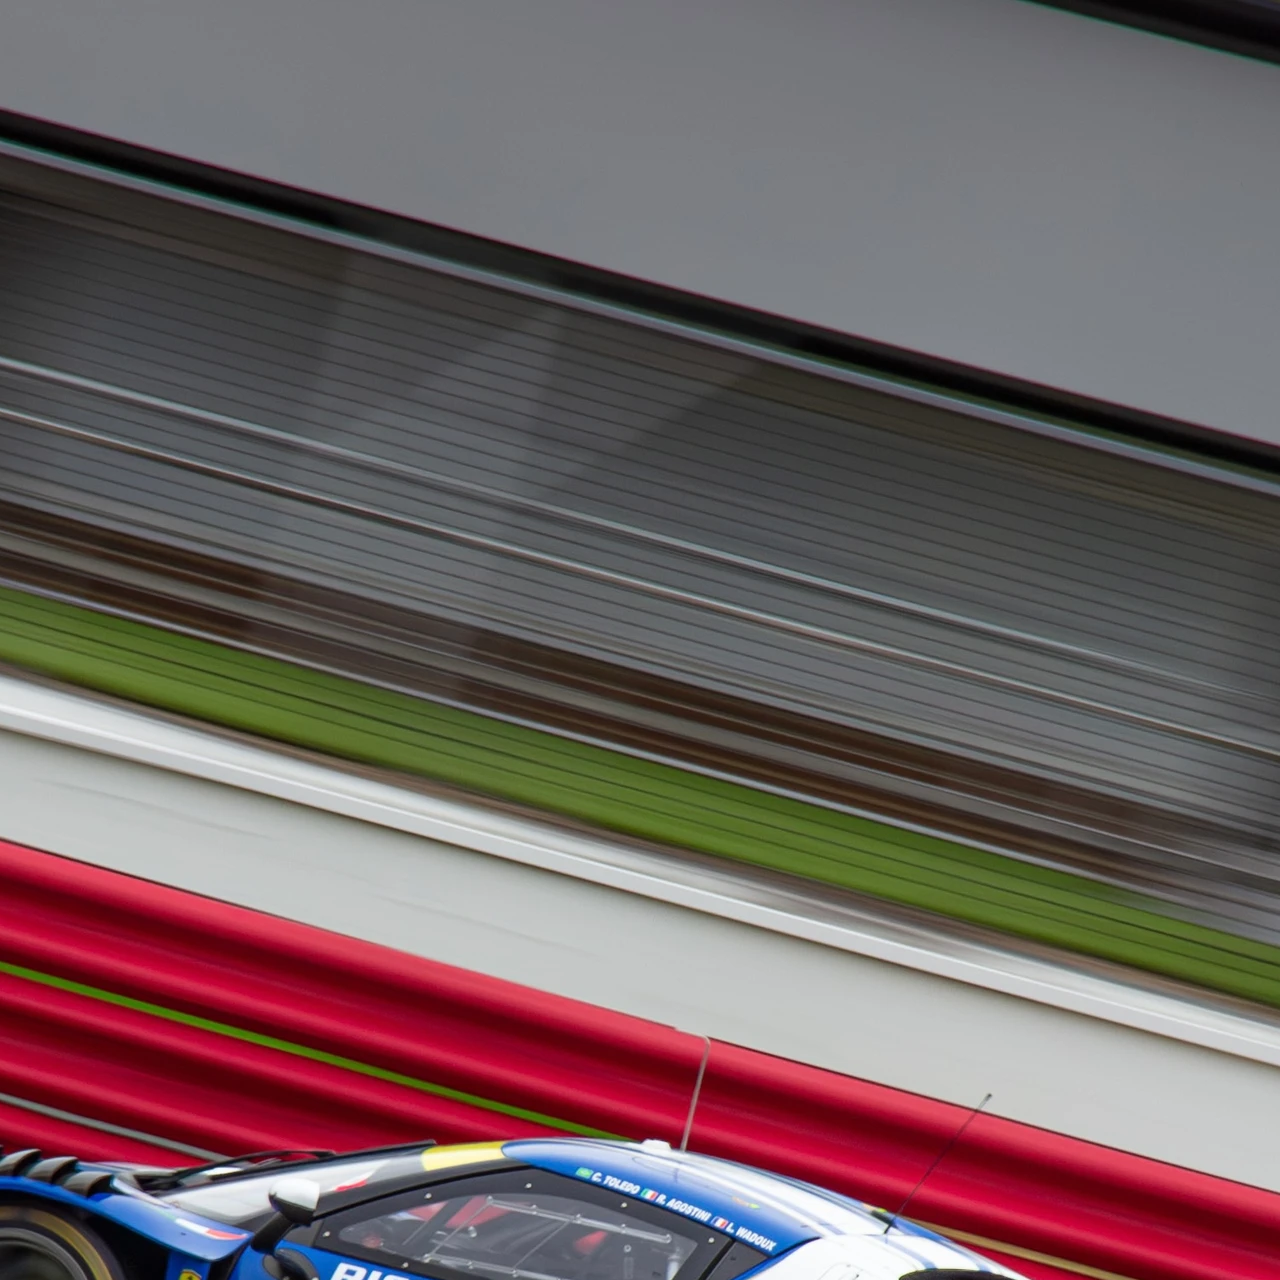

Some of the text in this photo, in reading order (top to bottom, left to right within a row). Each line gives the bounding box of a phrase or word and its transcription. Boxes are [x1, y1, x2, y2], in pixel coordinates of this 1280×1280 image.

[591, 1172, 640, 1194] C. TOLEDO
[655, 1194, 712, 1222] R. AGOSTINI
[725, 1222, 777, 1252] L. WADOUX
